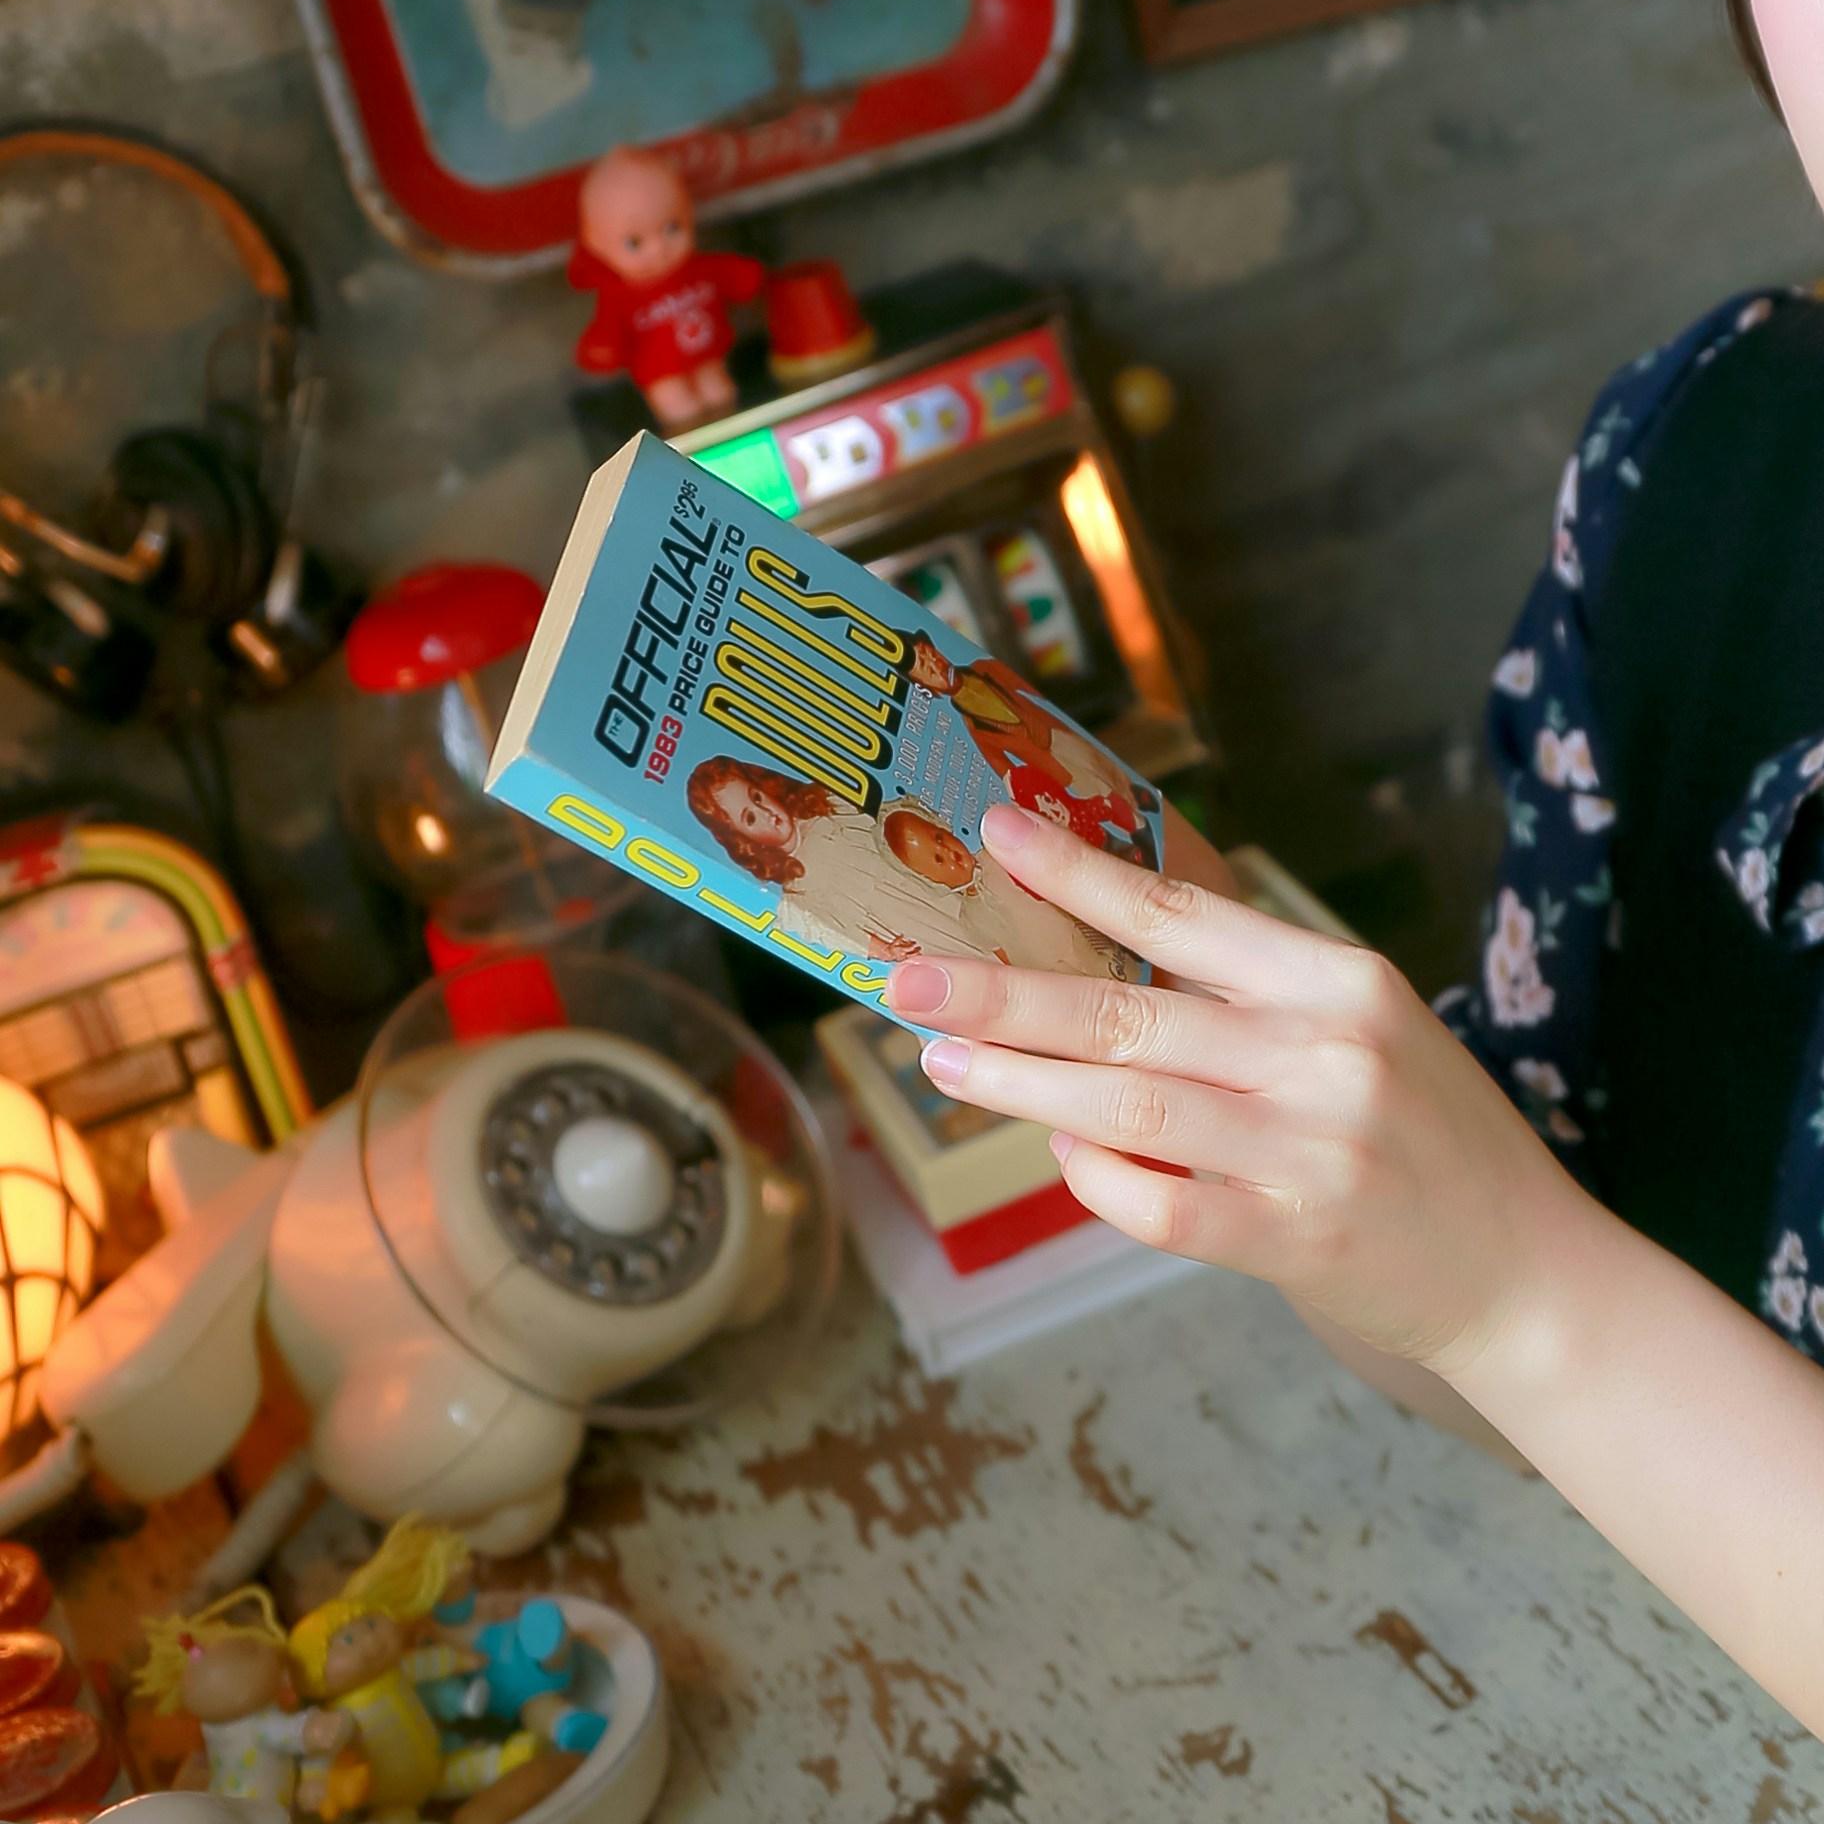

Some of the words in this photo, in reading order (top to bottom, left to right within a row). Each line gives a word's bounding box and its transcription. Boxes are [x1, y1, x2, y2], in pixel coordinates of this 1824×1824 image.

[594, 515, 719, 768] OFFICIAL
[643, 714, 683, 784] 1983
[668, 636, 709, 716] PRICE
[694, 558, 735, 637] GUIDE
[720, 523, 746, 558] TO
[701, 547, 911, 814] DOLLS
[608, 714, 625, 738] THE
[906, 682, 934, 738] PRICES
[935, 709, 953, 737] AND
[924, 737, 947, 786] MODERN
[947, 735, 969, 776] DOLLS
[917, 786, 936, 813] FOR
[938, 773, 962, 826] ANTIQUE
[546, 793, 891, 1009] DOLLS
